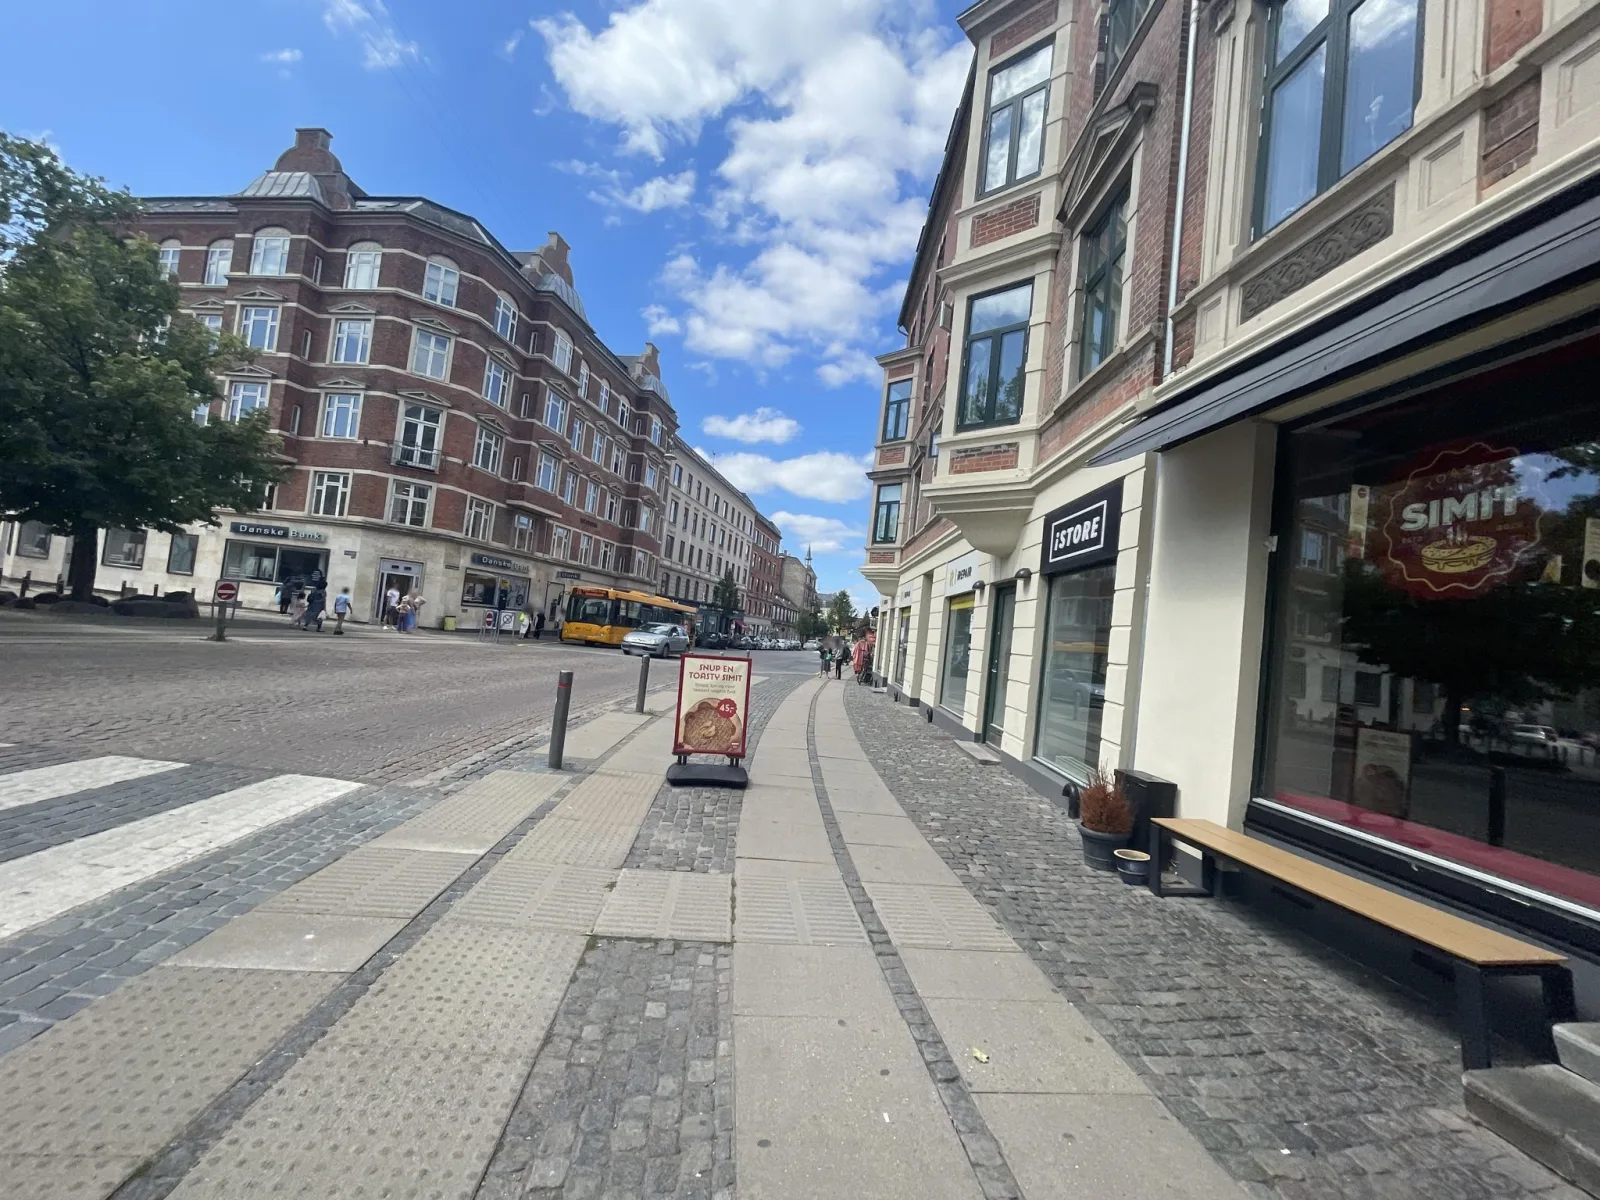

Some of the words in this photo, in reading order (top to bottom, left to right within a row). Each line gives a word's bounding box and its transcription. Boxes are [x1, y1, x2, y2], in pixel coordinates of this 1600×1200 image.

[1400, 485, 1526, 532] SIMIT
[239, 524, 284, 536] Danske
[1053, 516, 1101, 551] iSTORE
[482, 556, 511, 568] Danske
[957, 566, 972, 580] REPAIR
[699, 663, 721, 671] SNUP
[723, 665, 734, 673] EN
[688, 671, 720, 680] TOASTY
[721, 674, 743, 682] SIMIT
